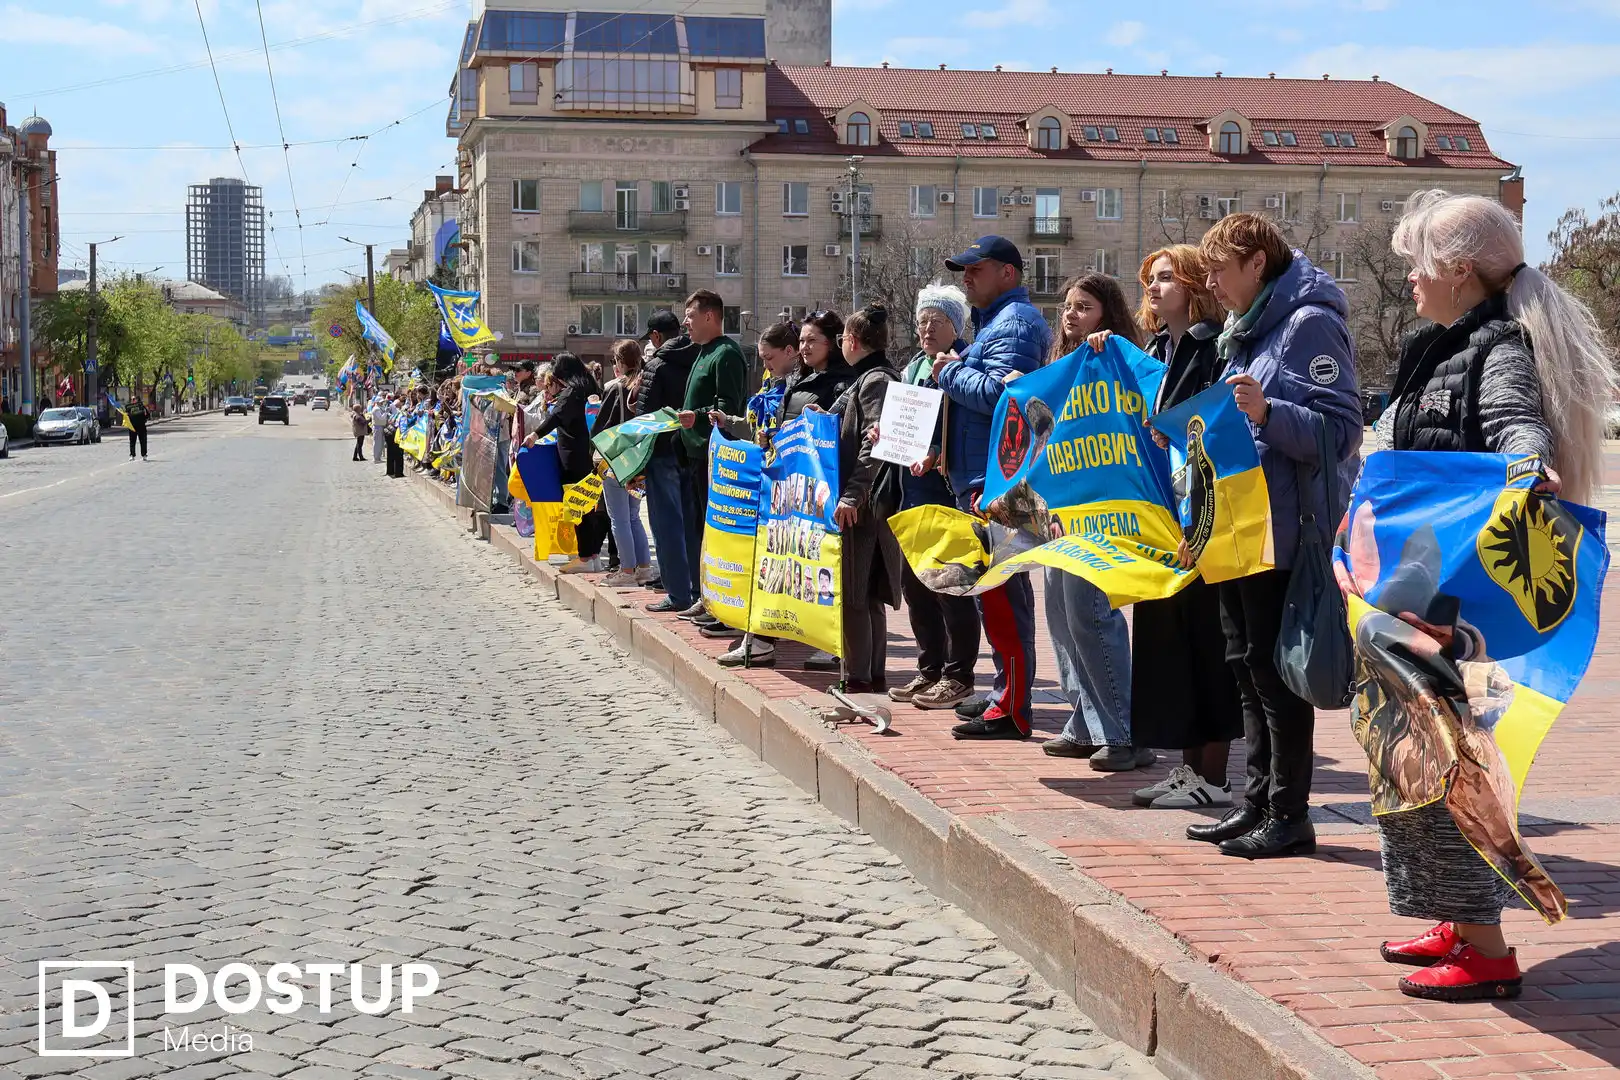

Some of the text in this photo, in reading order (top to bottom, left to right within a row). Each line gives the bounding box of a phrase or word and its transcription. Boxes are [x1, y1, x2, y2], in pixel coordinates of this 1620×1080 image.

[1057, 380, 1110, 424] ЕНКО
[1046, 432, 1143, 475] ПАВЛОВИЧ
[1083, 512, 1142, 537] ОКРЕМА
